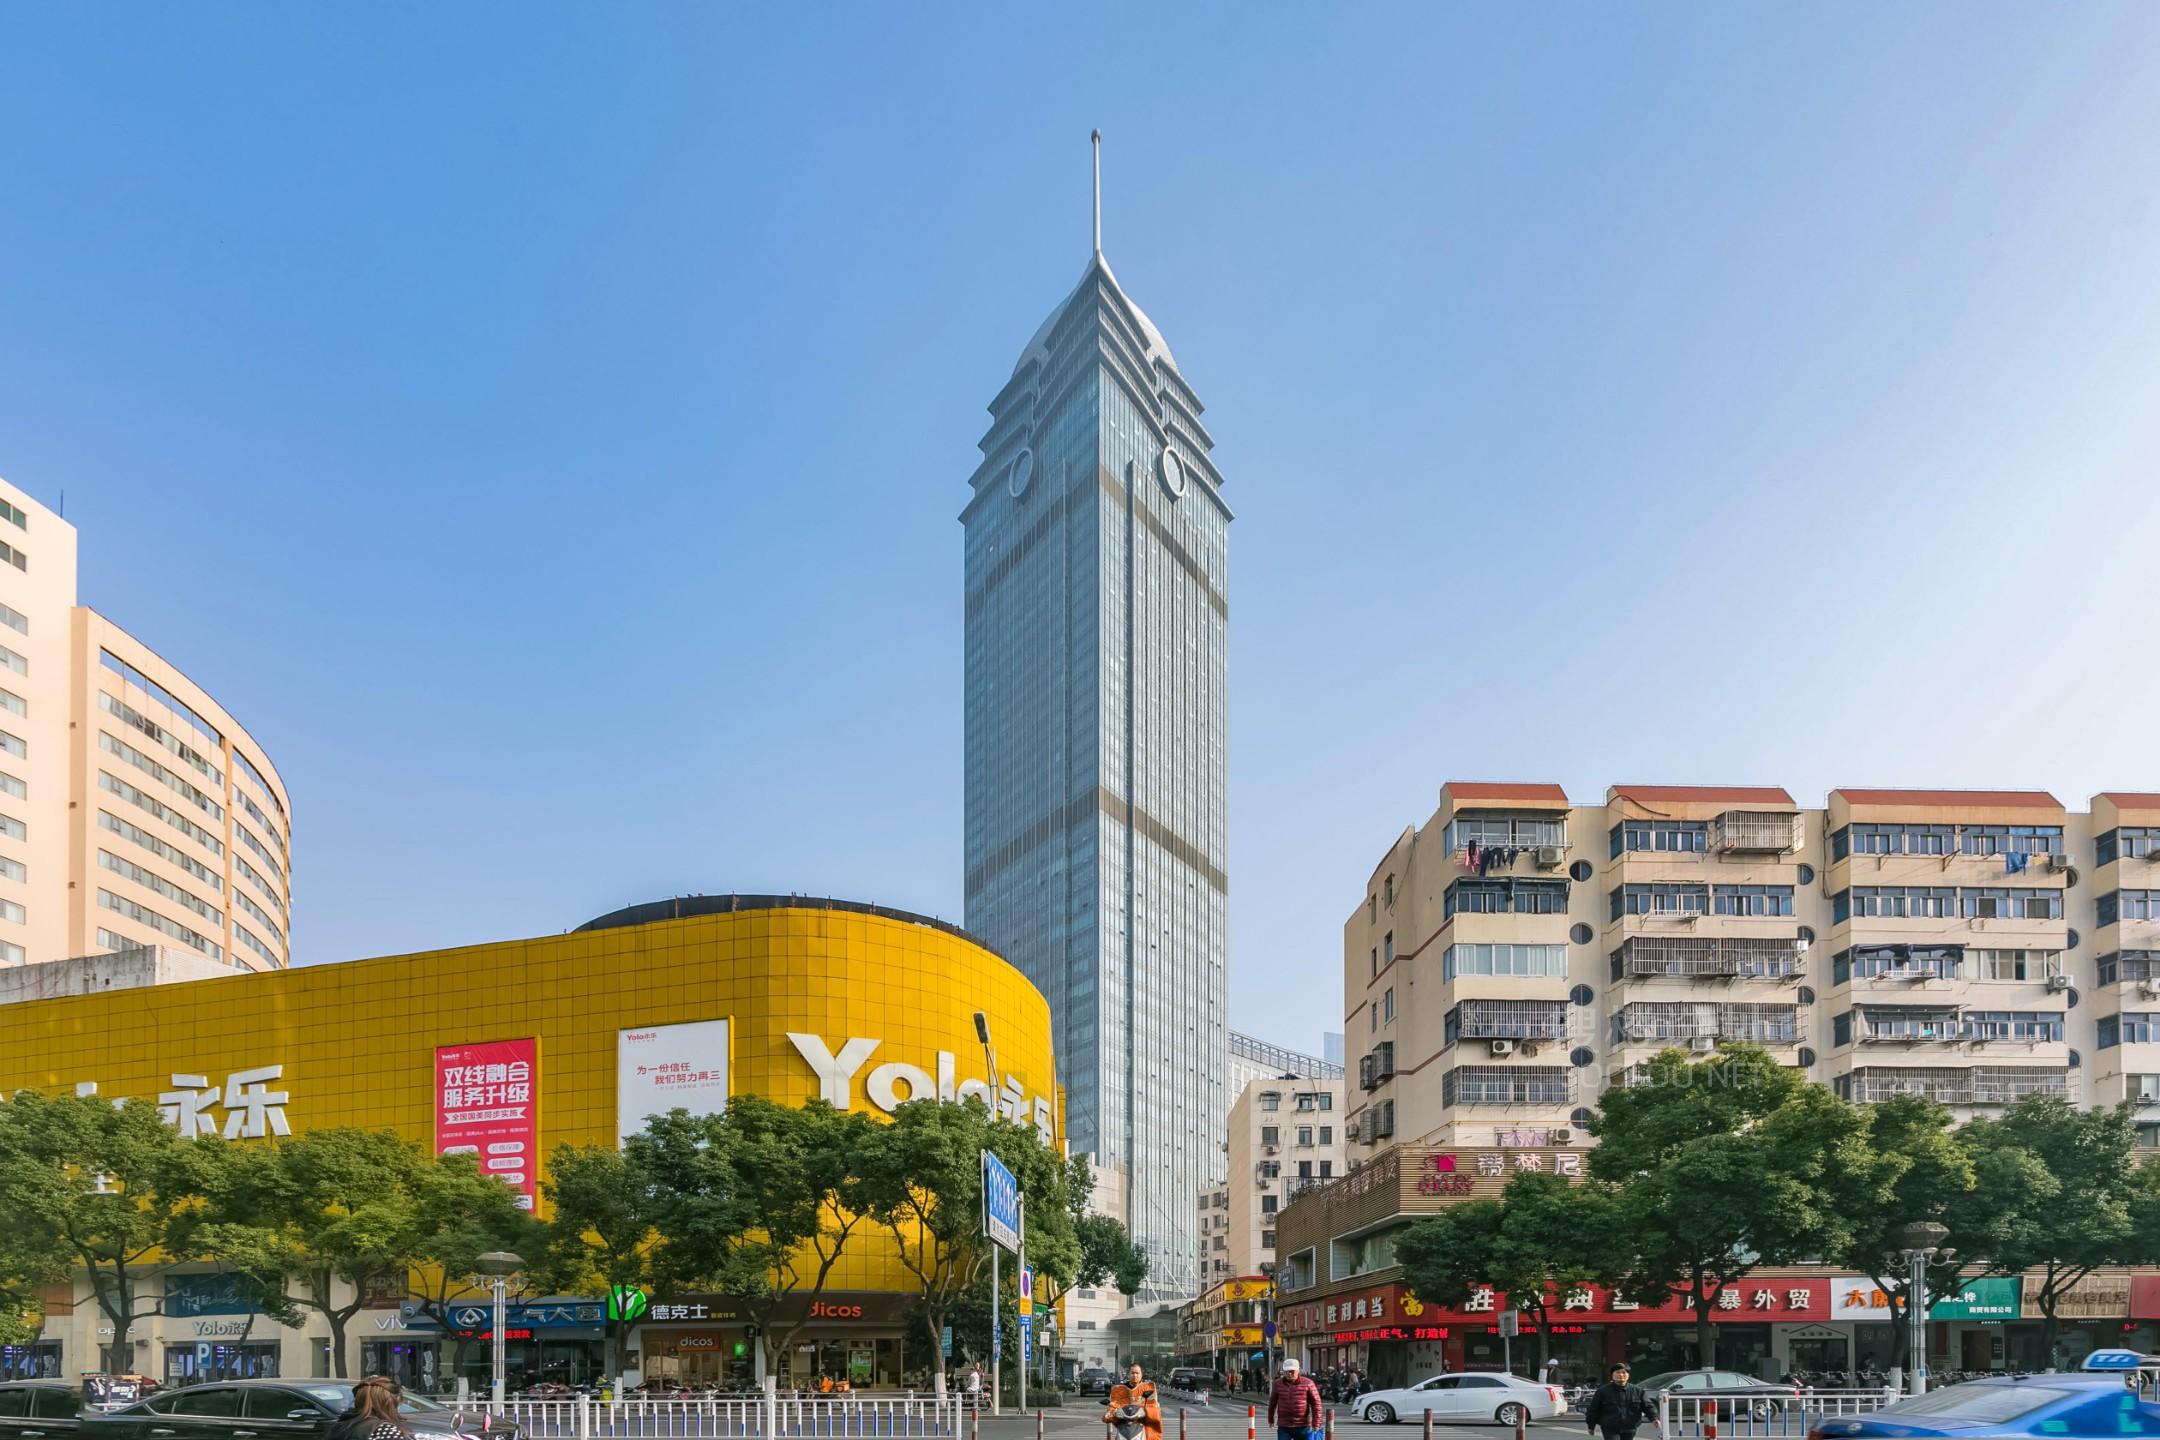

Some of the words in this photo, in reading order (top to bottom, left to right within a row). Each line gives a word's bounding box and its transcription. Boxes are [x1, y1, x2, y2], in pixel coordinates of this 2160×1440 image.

[444, 1061, 529, 1087] 双线融合
[636, 1062, 690, 1075] 为一份信任
[655, 1070, 720, 1085] 我们努力再三
[443, 1082, 529, 1108] 服务升级
[1685, 1289, 1811, 1310] 暴外贸
[651, 1304, 709, 1320] 德克士
[1327, 1296, 1384, 1324] 胜利典当
[1968, 1306, 2012, 1314] 商贸有限公司
[375, 1314, 408, 1331] viv
[98, 1327, 136, 1336] opo
[680, 1336, 714, 1347] dicos
[198, 1343, 210, 1359] P
